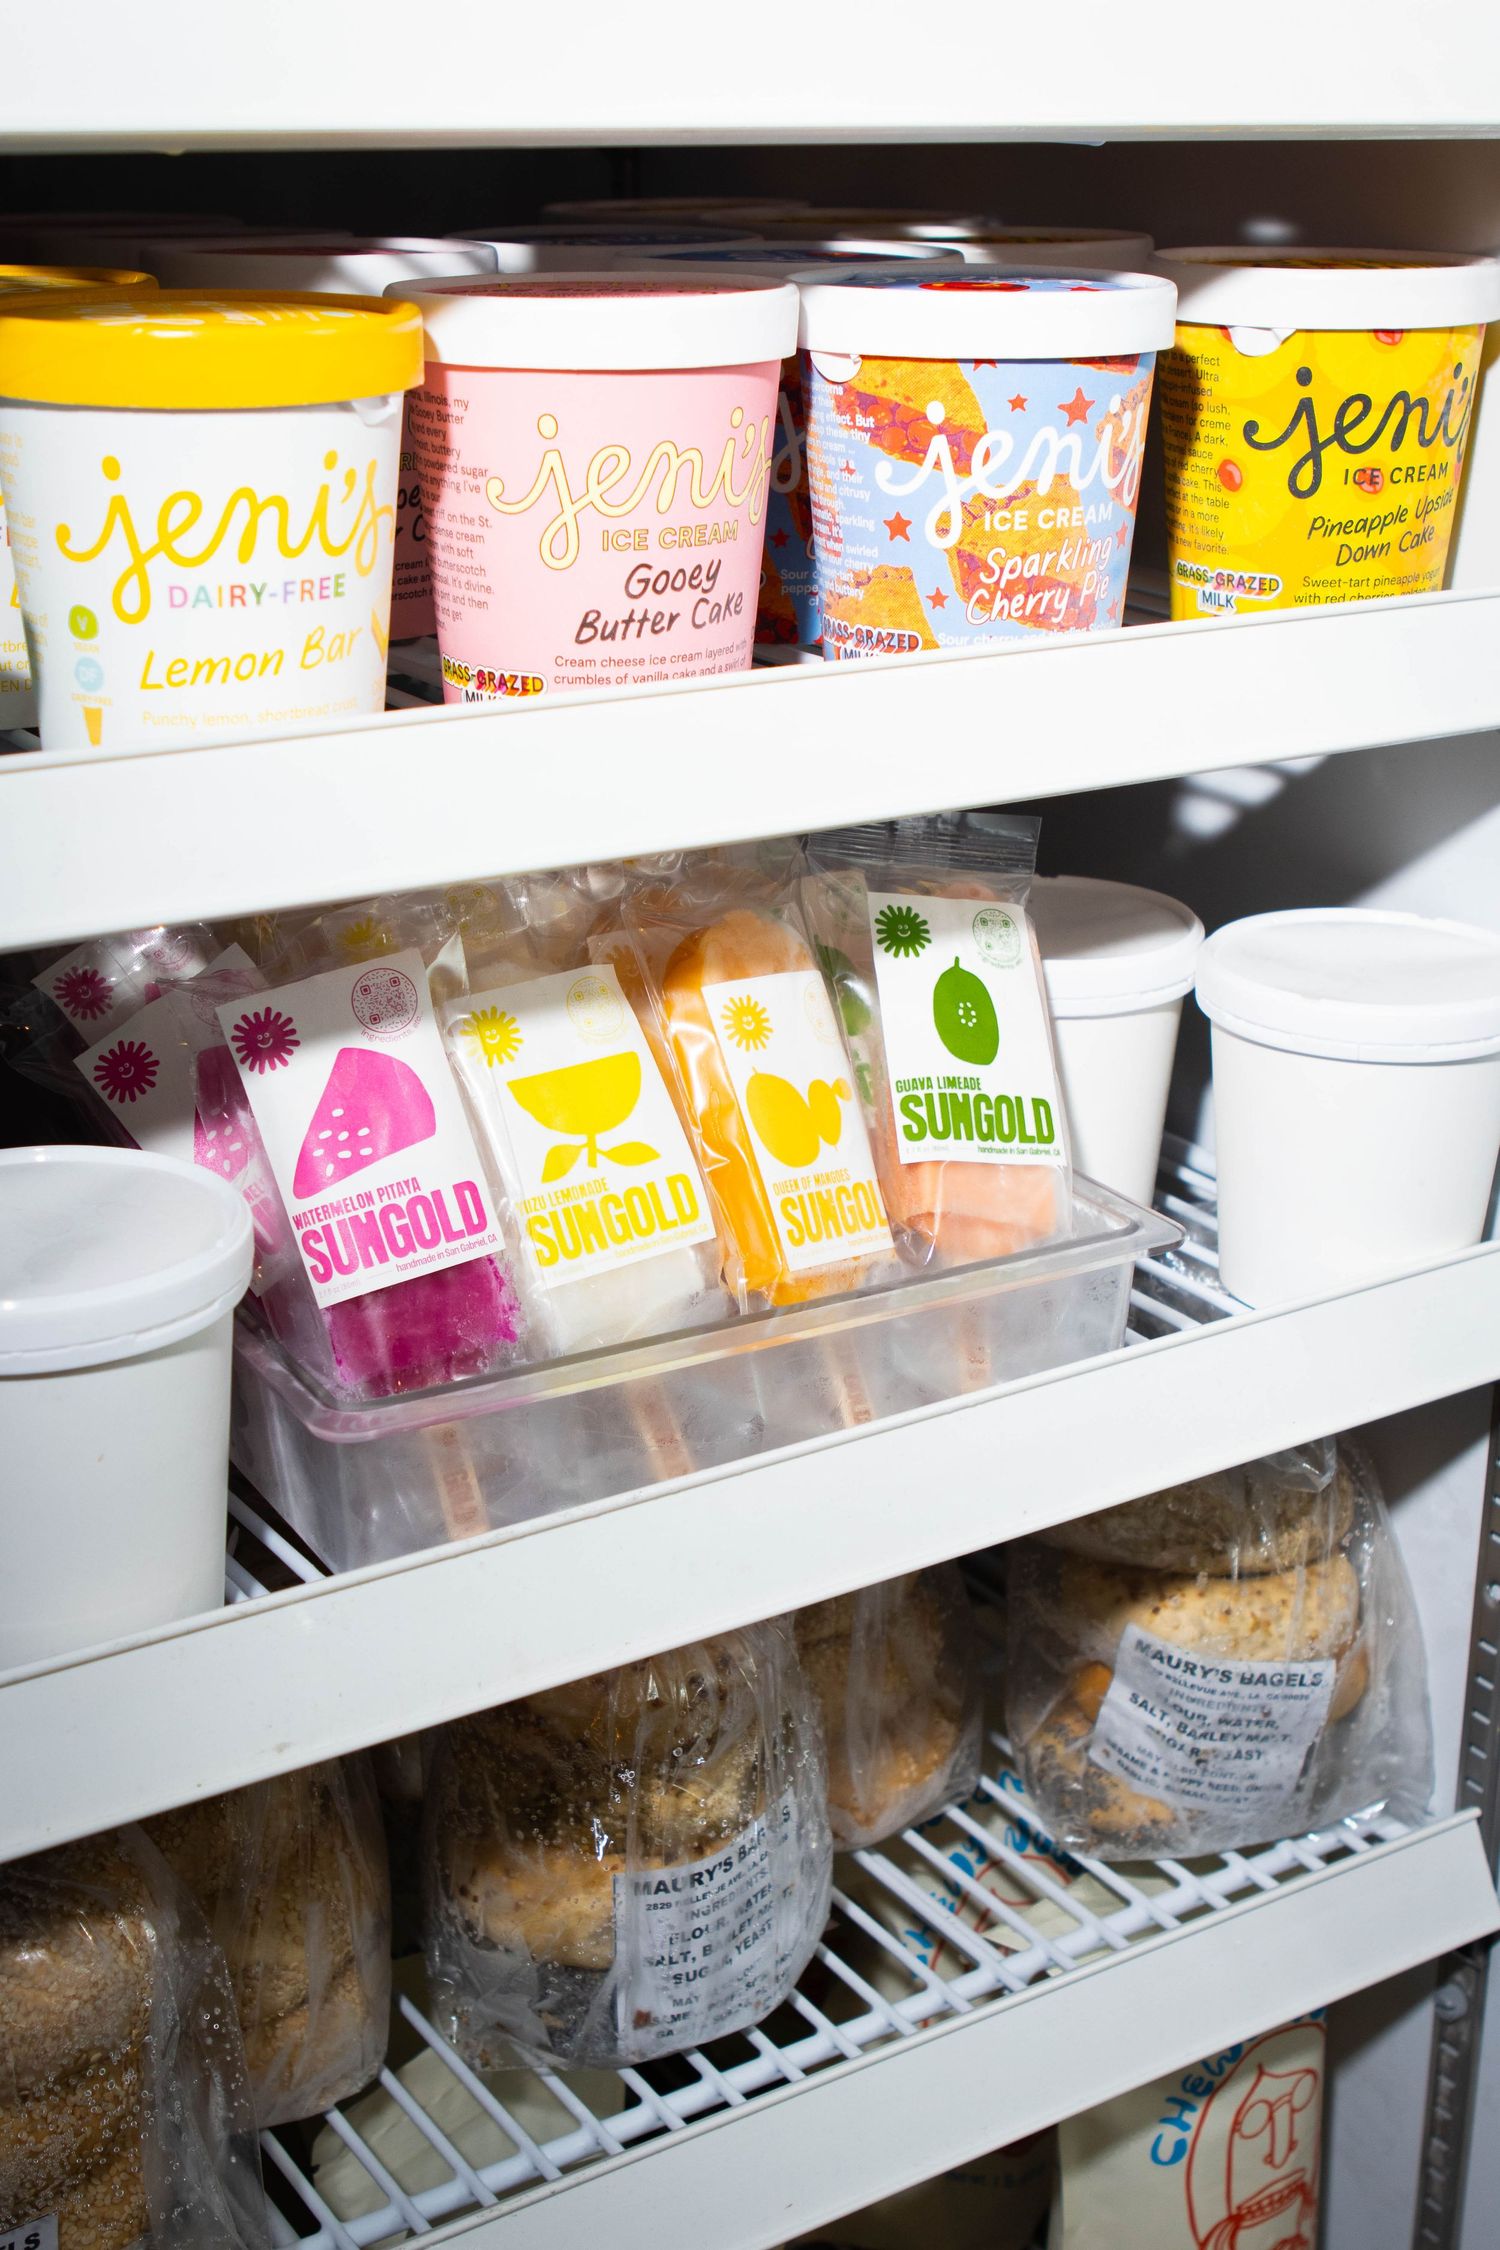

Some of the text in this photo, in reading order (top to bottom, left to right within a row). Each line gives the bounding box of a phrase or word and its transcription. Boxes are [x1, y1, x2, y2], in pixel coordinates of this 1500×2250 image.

[1186, 354, 1220, 366] perfect
[1196, 369, 1219, 382] Ultra
[454, 398, 469, 411] my
[1207, 402, 1230, 415] lush,
[436, 409, 464, 424] Butter
[856, 414, 875, 428] But
[1200, 418, 1231, 430] creme
[850, 428, 871, 444] tiny
[432, 444, 461, 460] buttery
[461, 465, 488, 479] sugar
[875, 394, 1144, 549] jeni's
[1343, 462, 1449, 486] ICE CREAM
[464, 480, 481, 493] I've
[486, 406, 772, 570] jeni's
[839, 486, 870, 502] citrusy
[1204, 480, 1222, 492] This
[1191, 494, 1203, 505] the
[1207, 497, 1230, 509] table
[447, 512, 458, 522] on
[460, 514, 475, 526] the
[478, 515, 493, 528] St.
[985, 502, 1112, 531] ICE CREAM
[1197, 512, 1219, 523] more
[1307, 488, 1454, 540] Pineapple Upside
[55, 450, 394, 625] jeni's
[456, 531, 485, 544] cream
[602, 520, 739, 551] ICE CREAM
[1201, 526, 1224, 540] likely
[441, 544, 474, 559] with soft
[1336, 524, 1435, 567] Down Cake
[438, 558, 486, 577] butterscotch
[844, 558, 873, 574] cherry
[980, 535, 1112, 585] Sparkling
[624, 559, 721, 600] Gooey
[781, 568, 808, 581] Sour
[1176, 562, 1280, 594] GRASS-GRAZED
[1303, 575, 1370, 588] Sweet-tart
[1373, 571, 1420, 590] pineapple
[169, 573, 346, 609] DAIRY-FREE
[394, 588, 429, 600] rscotch
[464, 579, 494, 595] divine.
[781, 583, 818, 597] peppe
[452, 592, 489, 610] and then
[966, 570, 1109, 625] Cherry Pie
[1202, 590, 1235, 609] MILK
[1294, 594, 1321, 604] with
[1325, 593, 1345, 604] red
[574, 590, 743, 645] Butter Cake
[823, 614, 919, 650] GRASS-GRAZED
[938, 633, 968, 647] Sour
[139, 624, 363, 692] Lemon Bar
[554, 656, 597, 668] Cream
[601, 654, 646, 667] cheese
[649, 653, 666, 666] ice
[670, 651, 704, 664] cream
[705, 643, 734, 662] layered
[443, 656, 544, 694] GRASS-GRAZED
[554, 673, 612, 686] crumbles
[616, 672, 629, 685] of
[632, 670, 669, 684] vanilla
[142, 710, 197, 731] Punchy
[257, 702, 332, 725] shortbread
[896, 1076, 982, 1093] GUAVA LIMEADE
[900, 1092, 1055, 1145] SUNGOLD
[772, 1168, 852, 1197] QUEEN OF MANGOES
[292, 1190, 376, 1231] WATERMELON
[376, 1177, 421, 1204] PITAYA
[516, 1176, 609, 1214] UZU LEMONADE
[525, 1173, 701, 1268] SUNGOLD
[780, 1179, 888, 1248] SUNGOL
[301, 1180, 487, 1284] SUNGOLD
[396, 1233, 498, 1272] handmade in San Gabriel, CA
[1135, 1638, 1322, 1688] MAURY'S BAGELS
[1129, 1692, 1242, 1743] SALT, BARLEY
[634, 1856, 734, 1897] MAURY'S
[645, 1902, 672, 1912] 2829
[734, 1920, 772, 1956] YEAST
[1150, 2035, 1258, 2166] CHEW
